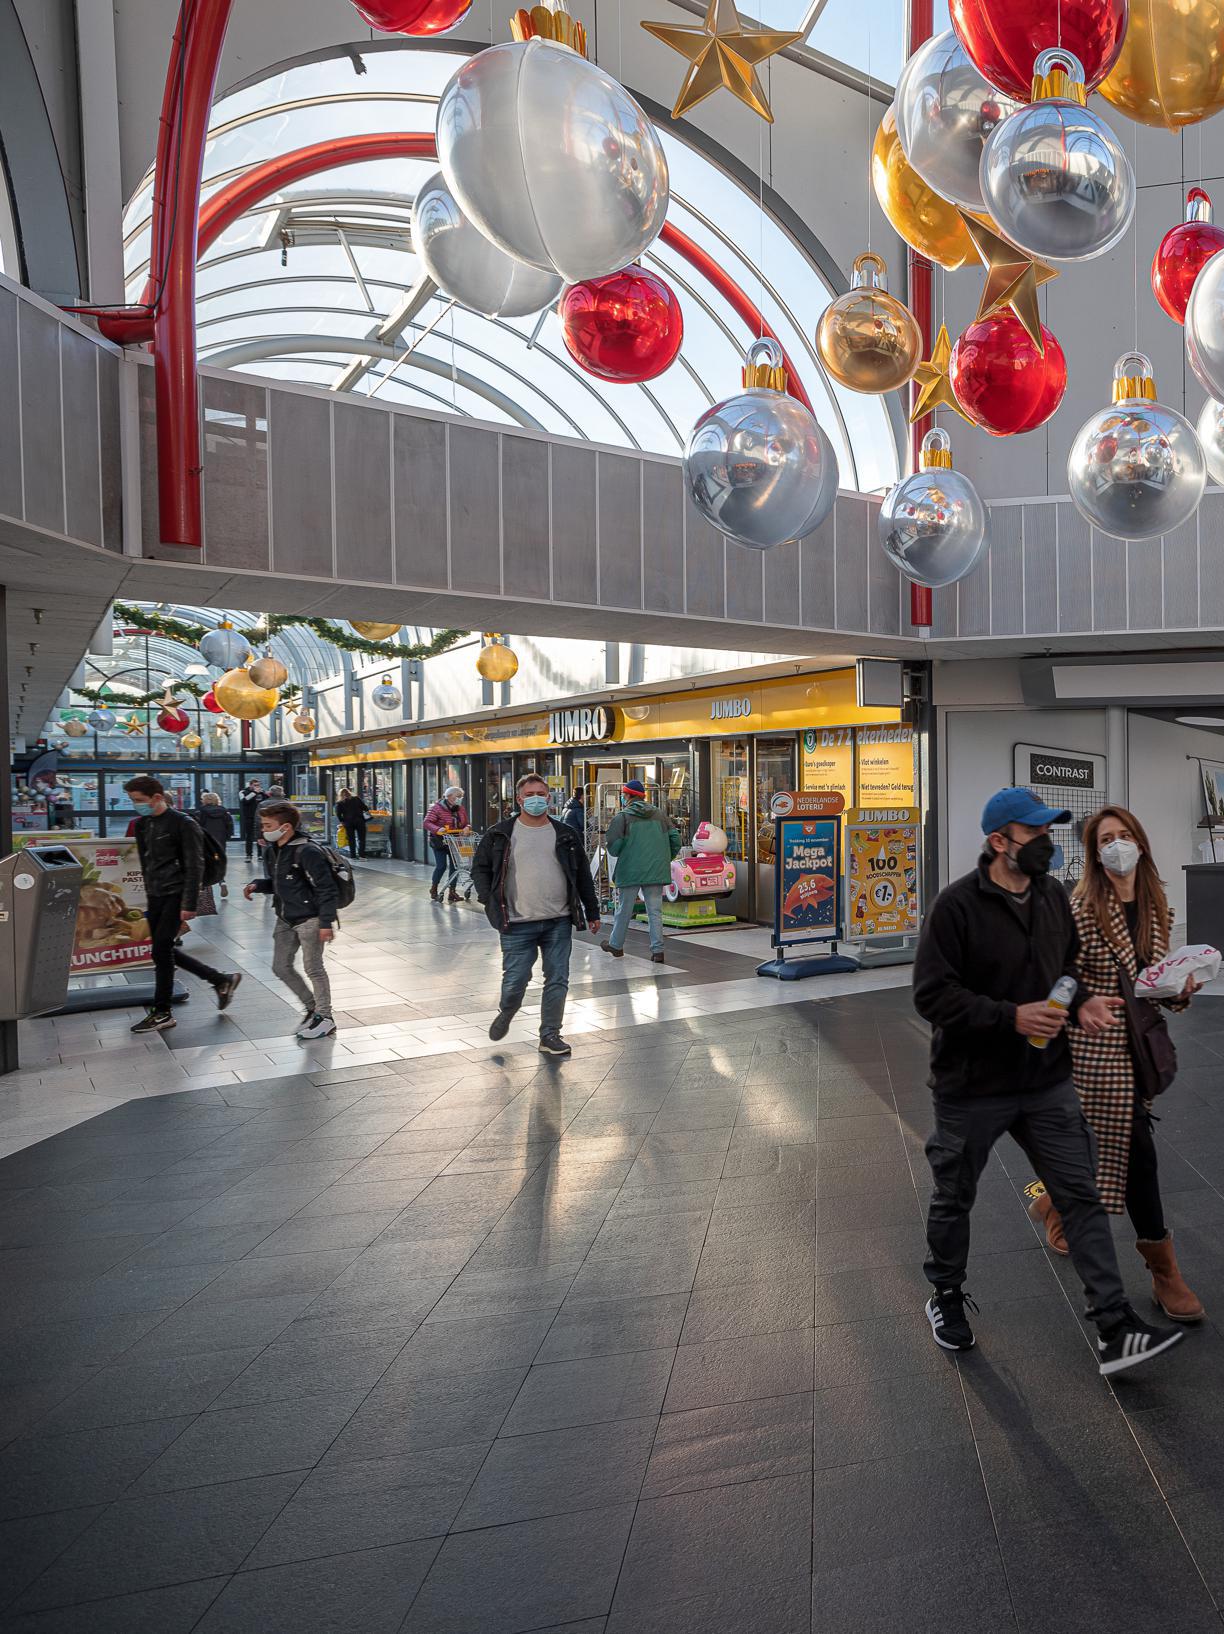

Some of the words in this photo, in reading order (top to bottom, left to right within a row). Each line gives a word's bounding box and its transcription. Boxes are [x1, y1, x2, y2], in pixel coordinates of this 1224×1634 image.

[710, 697, 752, 720] JUMBO
[547, 705, 607, 744] JUMBO
[820, 731, 834, 747] De
[836, 729, 845, 746] 7
[870, 758, 889, 766] winkelen
[1036, 764, 1089, 779] CONTRAST
[891, 783, 901, 791] Geld
[901, 783, 914, 792] terug
[796, 796, 839, 805] NEDERLANDSE
[797, 802, 824, 811] LOTERIJ
[857, 809, 911, 823] JUMBO
[793, 845, 825, 859] Mega
[785, 856, 833, 871] Jackpot
[868, 856, 898, 872] 100
[797, 879, 817, 894] 23,6
[70, 944, 153, 967] UNCHTIP!
